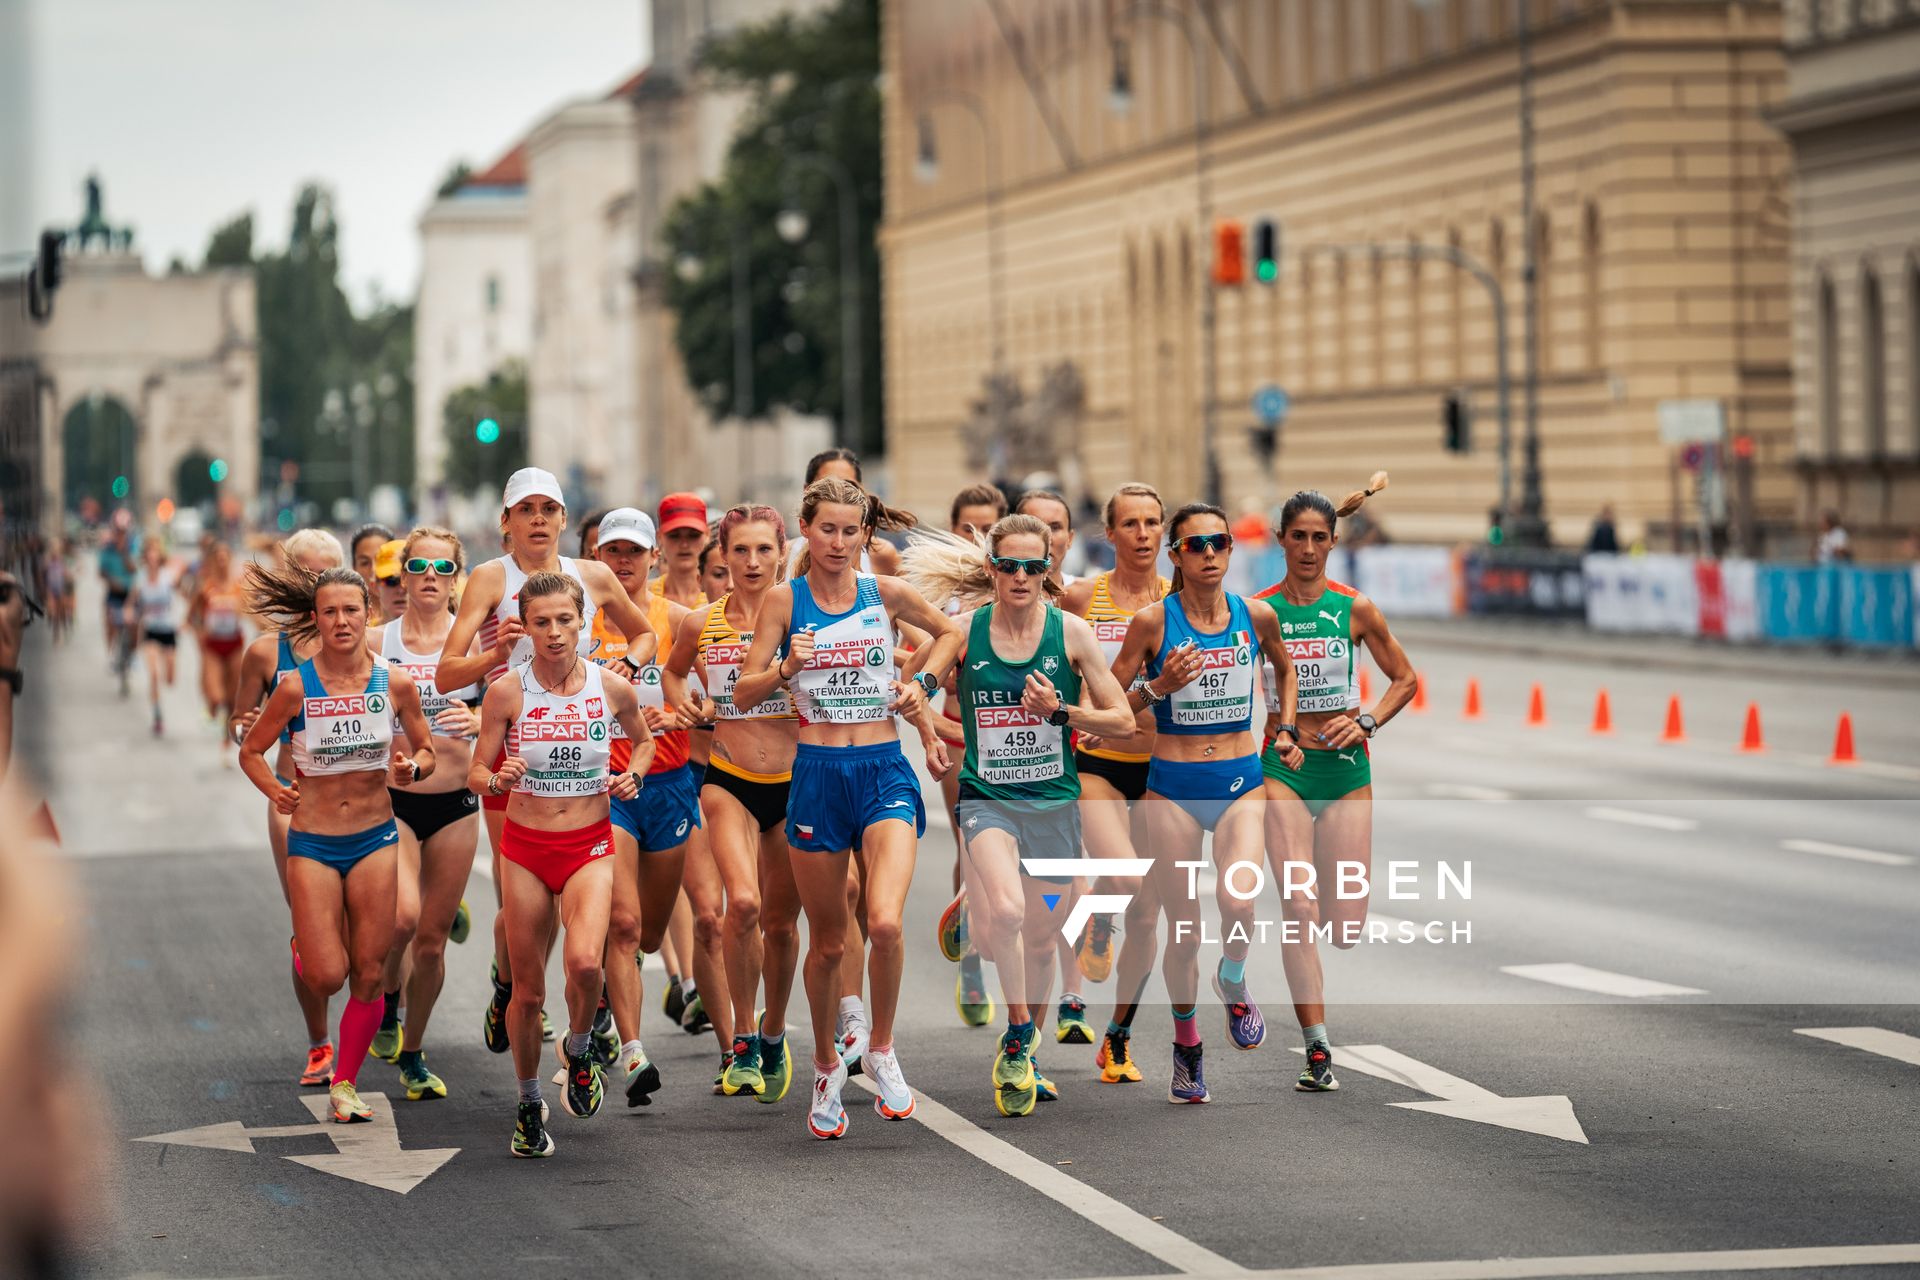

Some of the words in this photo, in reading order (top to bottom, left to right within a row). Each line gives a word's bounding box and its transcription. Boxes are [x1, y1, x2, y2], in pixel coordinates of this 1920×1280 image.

[1098, 626, 1127, 640] SP
[1295, 622, 1317, 632] JOGOS
[707, 648, 742, 662] SPA
[1286, 642, 1324, 657] PAR
[1202, 652, 1233, 667] AR
[408, 666, 435, 679] AR
[828, 671, 860, 686] 412
[1199, 673, 1229, 689] 467
[1298, 677, 1329, 687] REIRA
[809, 684, 880, 697] STEWARTOVÁ
[1204, 688, 1226, 698] EPIS
[1305, 689, 1329, 697] CLEAN
[307, 698, 364, 715] SPAR
[757, 702, 786, 714] 2022
[1320, 696, 1345, 708] 2022
[527, 707, 550, 720] 4F
[857, 708, 883, 720] 2022
[1177, 711, 1223, 722] MUNICH
[332, 720, 361, 735] 410
[522, 723, 586, 739] SPAR
[320, 732, 377, 745] HROCHOVÁ
[1005, 731, 1037, 747] 459
[549, 747, 582, 761] 486
[987, 744, 1053, 758] MCCORMACK
[549, 761, 580, 770] MACH
[1020, 758, 1044, 766] CLEAN
[983, 769, 1031, 781] MUNICH
[1035, 764, 1060, 778] 2022
[524, 778, 571, 792] MUNICH
[576, 778, 602, 792] 2022
